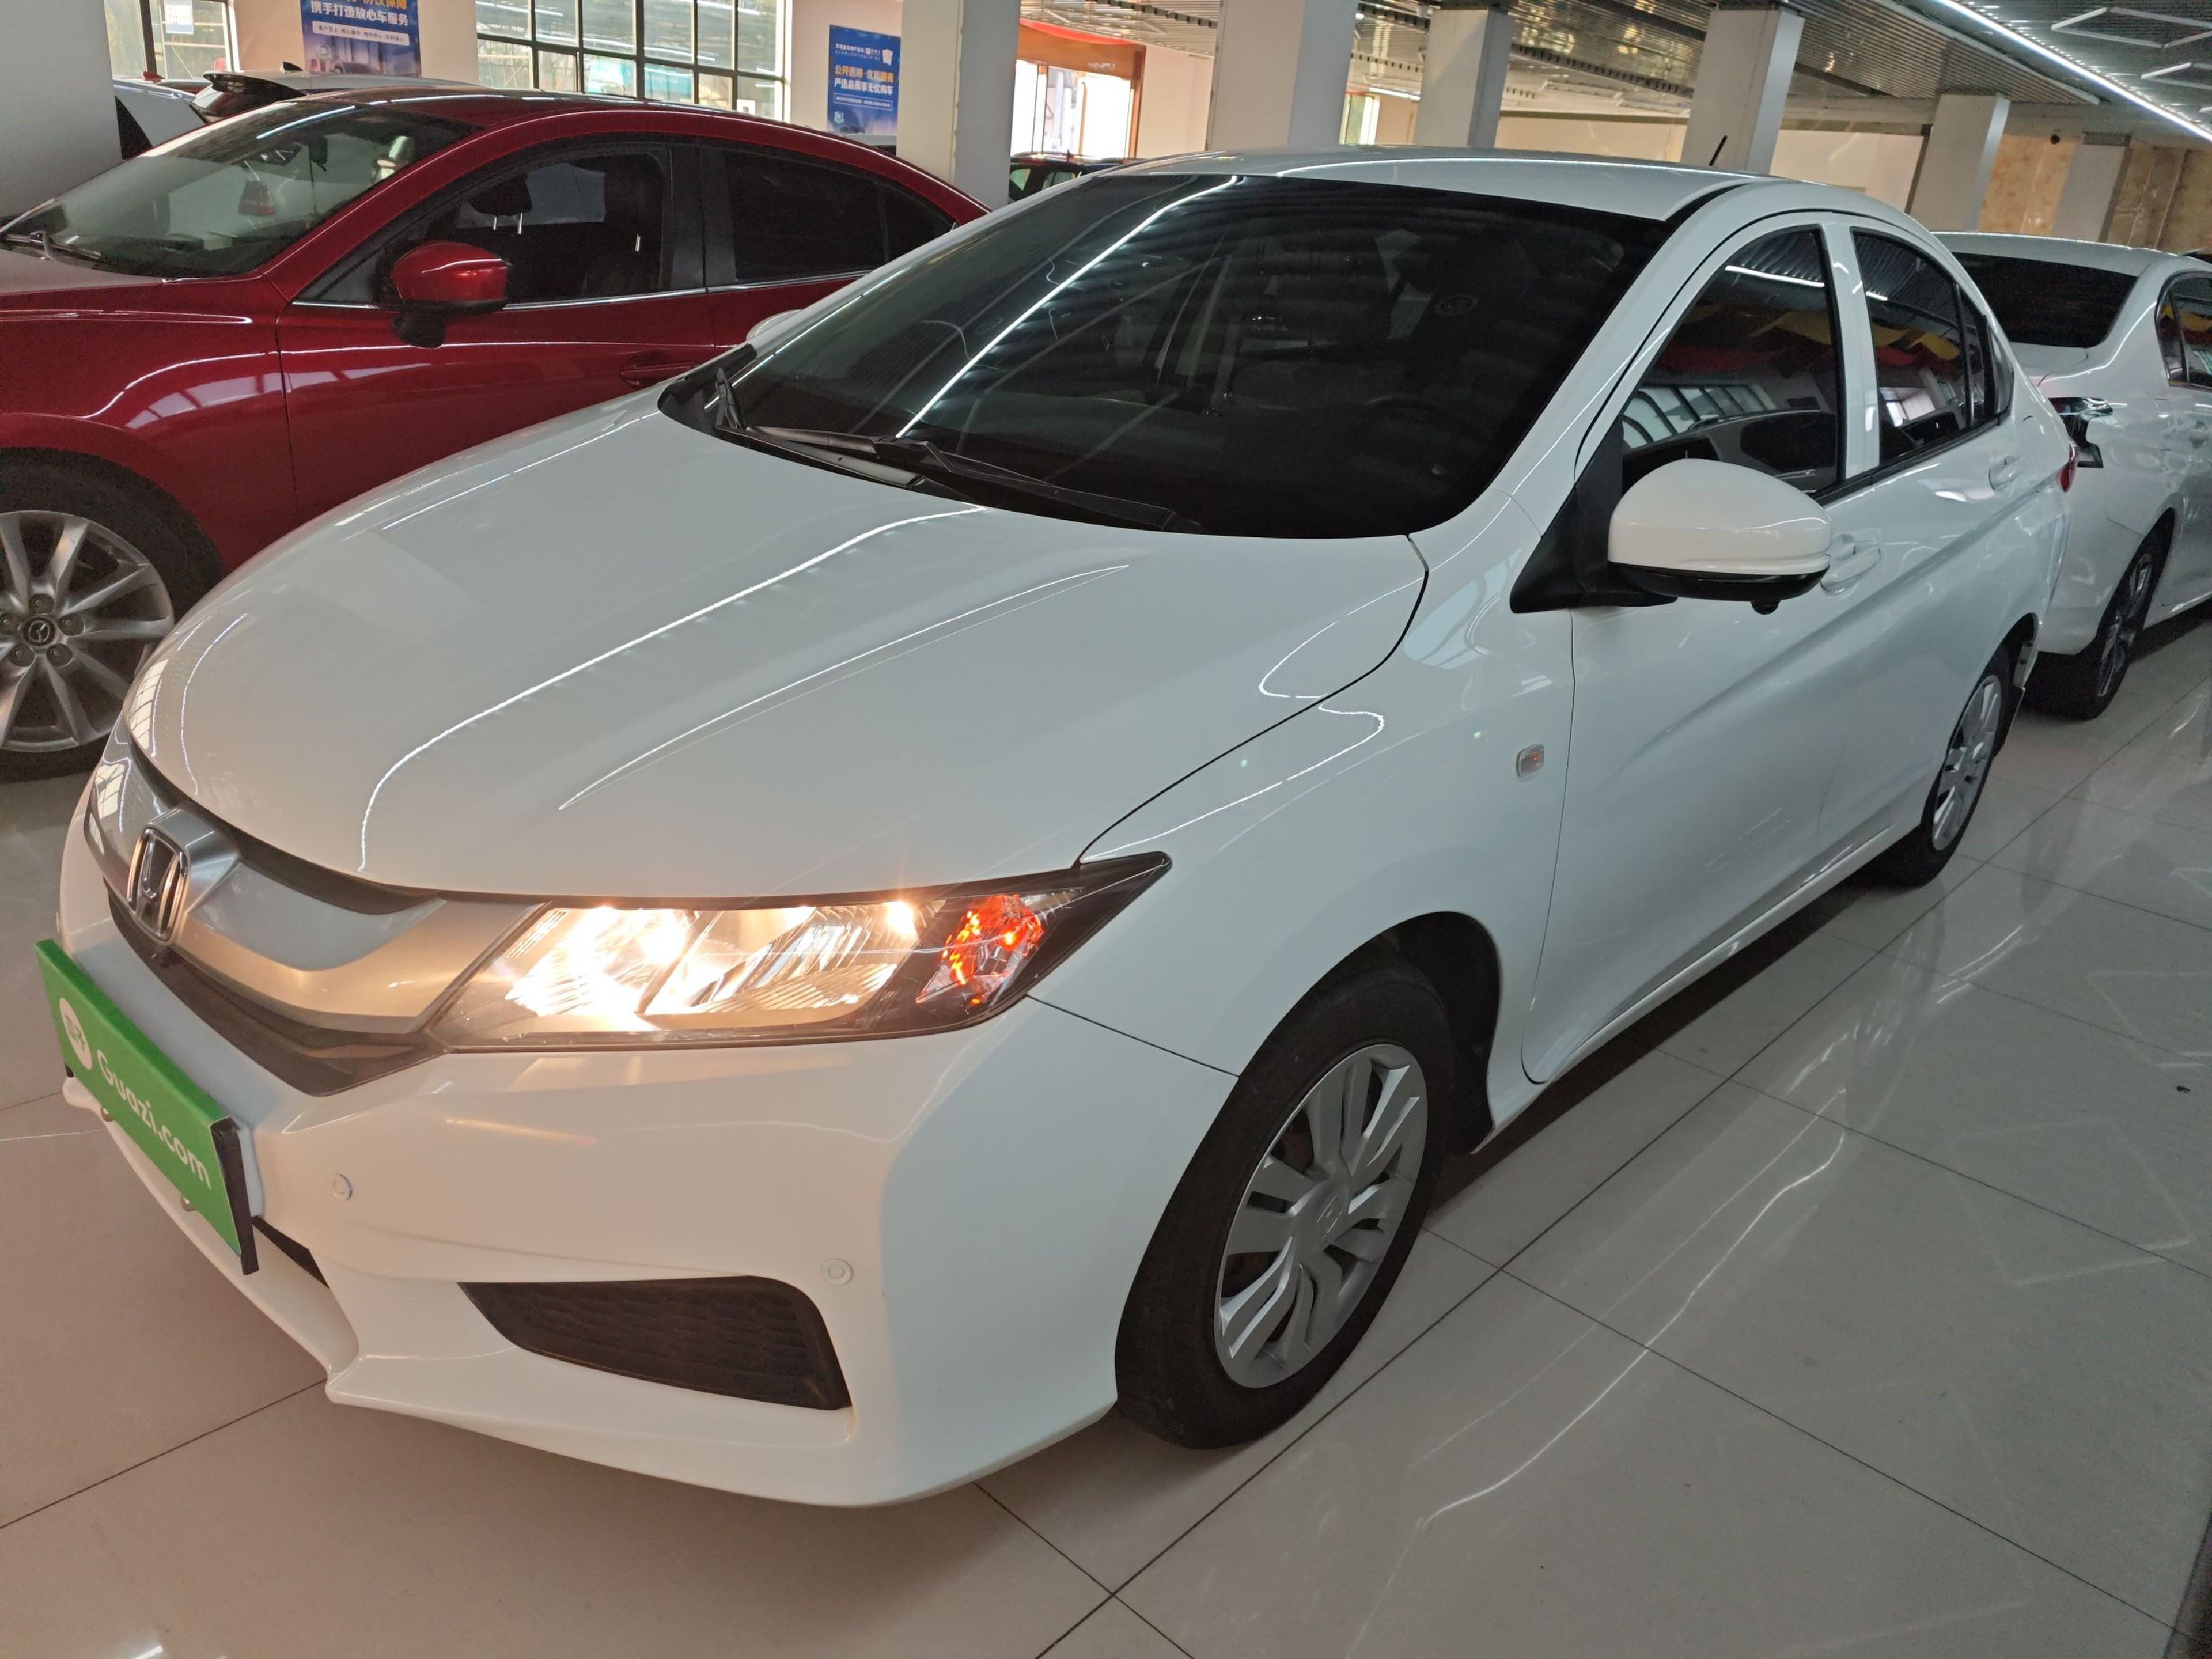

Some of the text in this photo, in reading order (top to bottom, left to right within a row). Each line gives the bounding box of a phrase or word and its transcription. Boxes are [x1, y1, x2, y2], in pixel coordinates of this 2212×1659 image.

[310, 1, 408, 26] 携手打造放心车服务
[96, 1049, 211, 1190] Guazi.com
